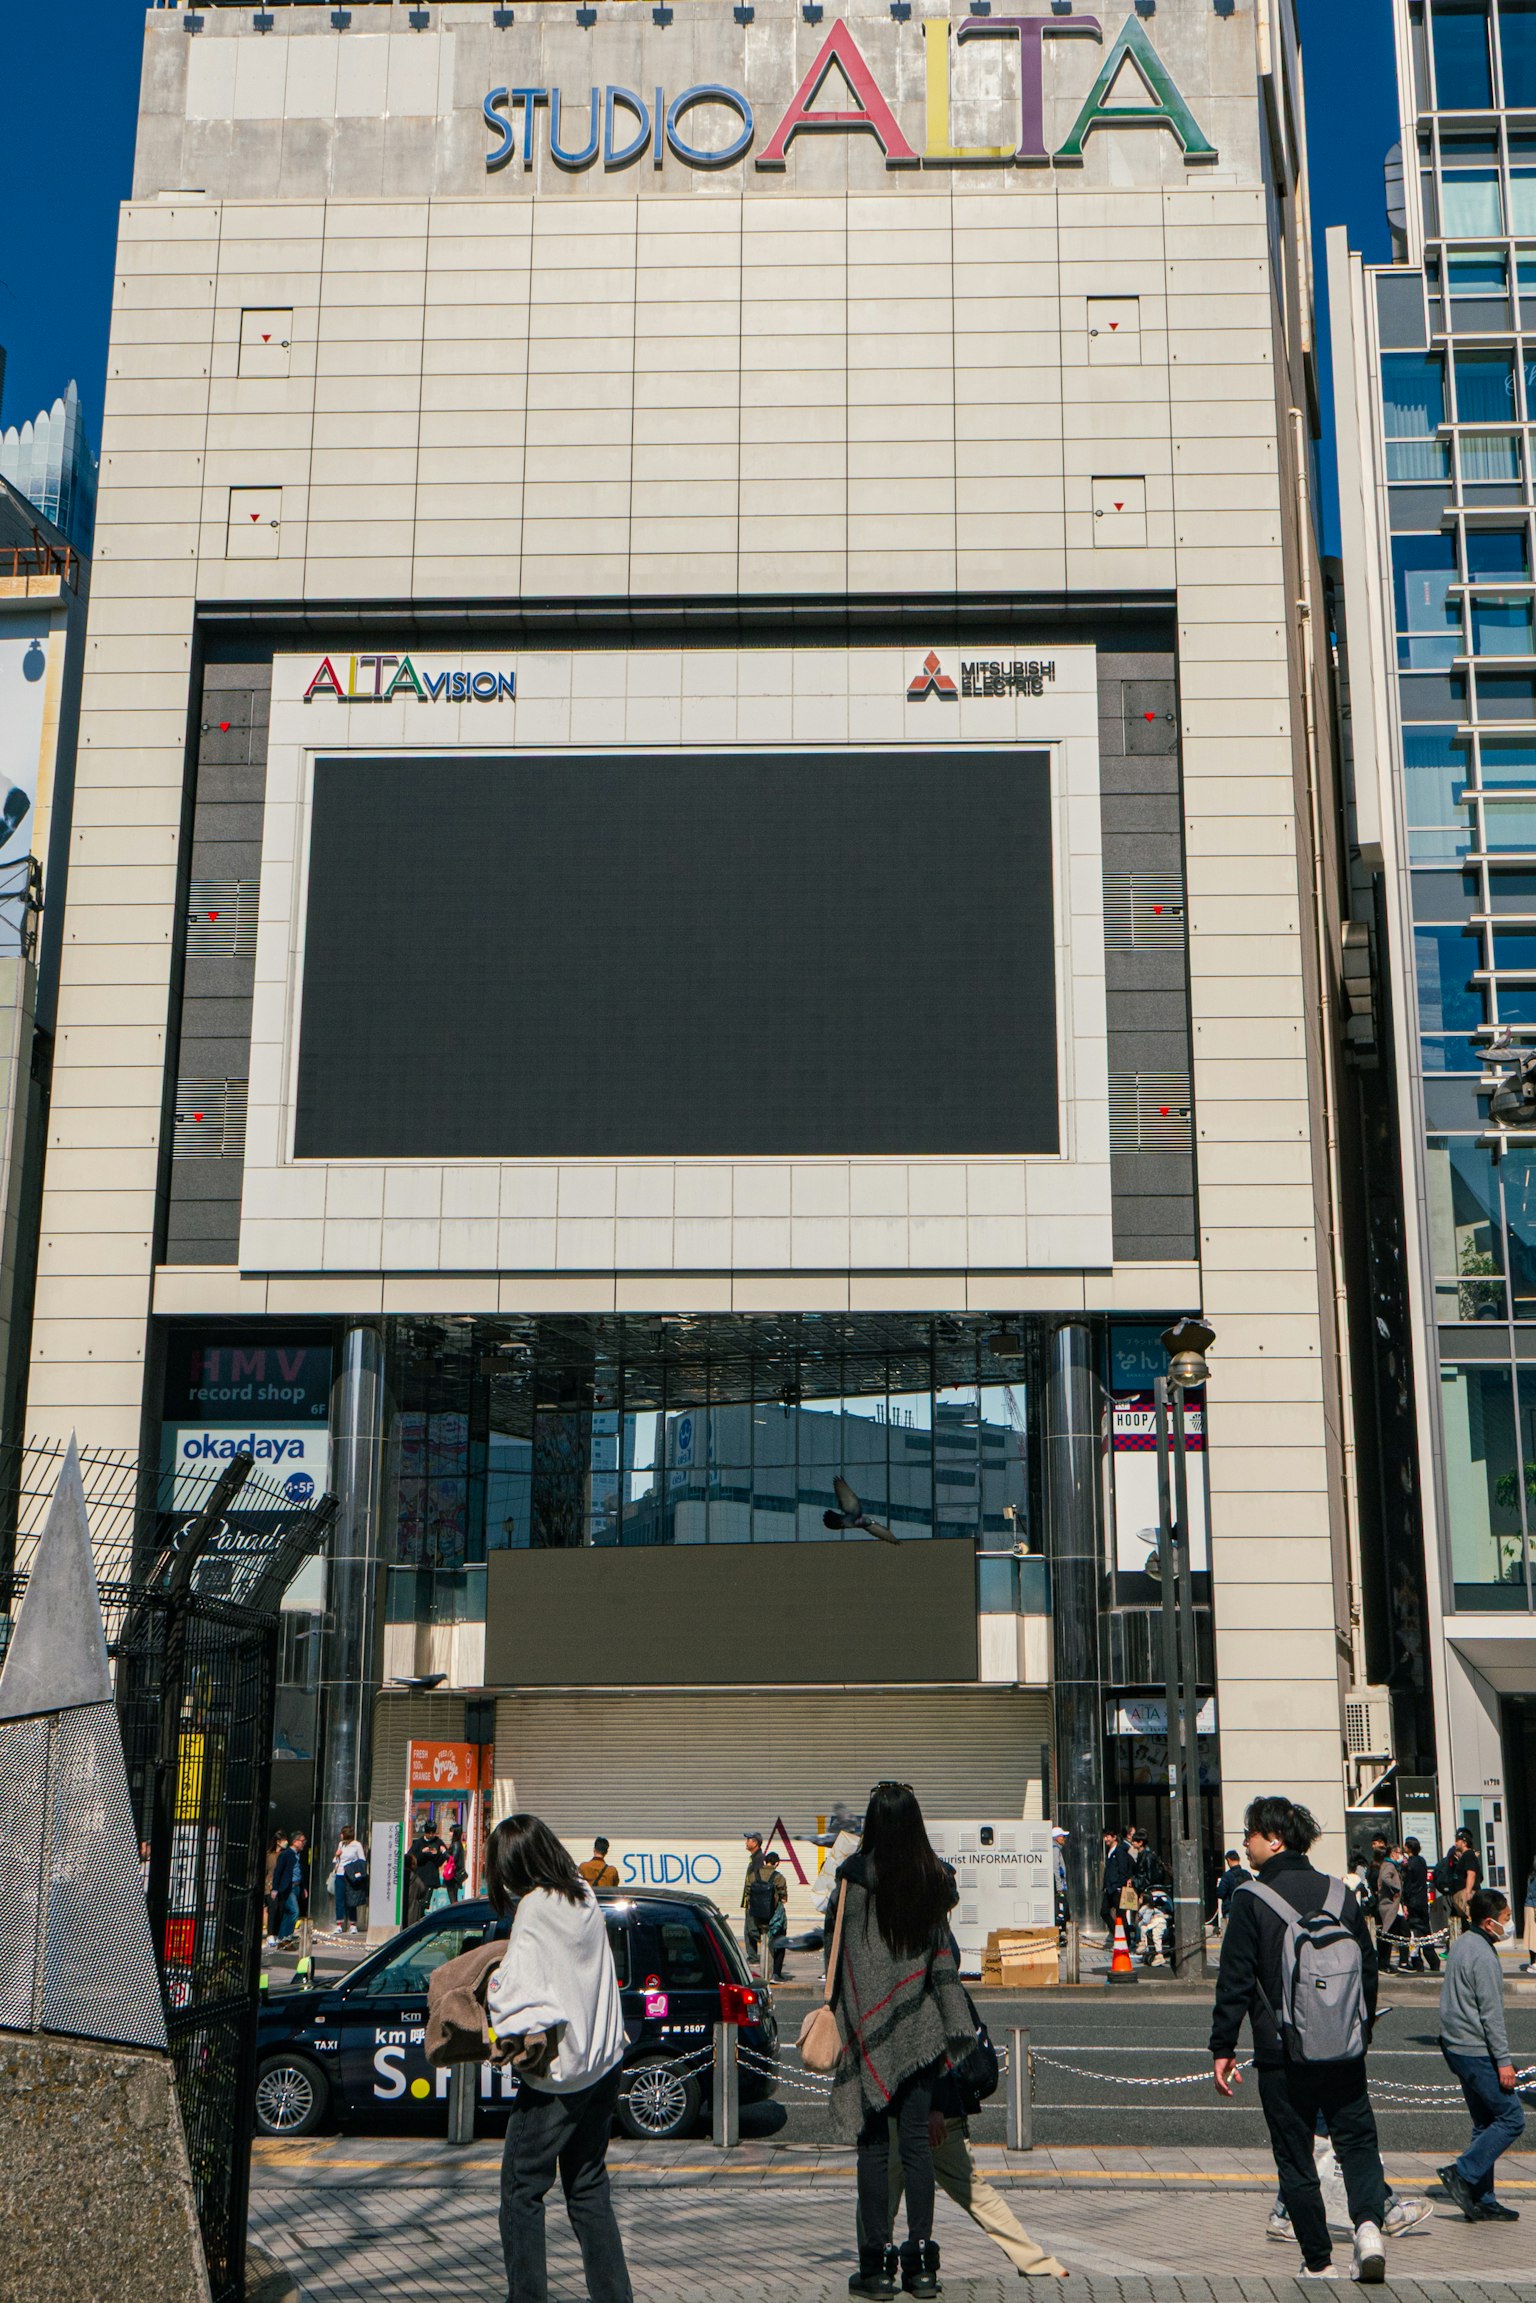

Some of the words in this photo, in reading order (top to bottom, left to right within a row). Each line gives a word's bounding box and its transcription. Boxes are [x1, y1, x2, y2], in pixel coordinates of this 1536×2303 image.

[484, 83, 754, 168] STUDIO
[755, 14, 1218, 166] ALTA
[961, 661, 1056, 677] MITSUBISHI
[961, 676, 1044, 695] ELECTRIC
[190, 1350, 306, 1382] HMV
[189, 1383, 252, 1400] record
[257, 1383, 306, 1404] shop
[311, 1404, 326, 1415] 6F
[183, 1433, 305, 1464] okadaya
[413, 1749, 429, 1759] FRESH
[412, 1772, 432, 1781] ORANGE
[969, 1854, 1042, 1864] INFORMATION
[623, 1853, 722, 1884] STUDIO
[375, 2027, 406, 2044] km
[684, 2025, 706, 2033] 2507
[314, 2040, 338, 2050] TAXI
